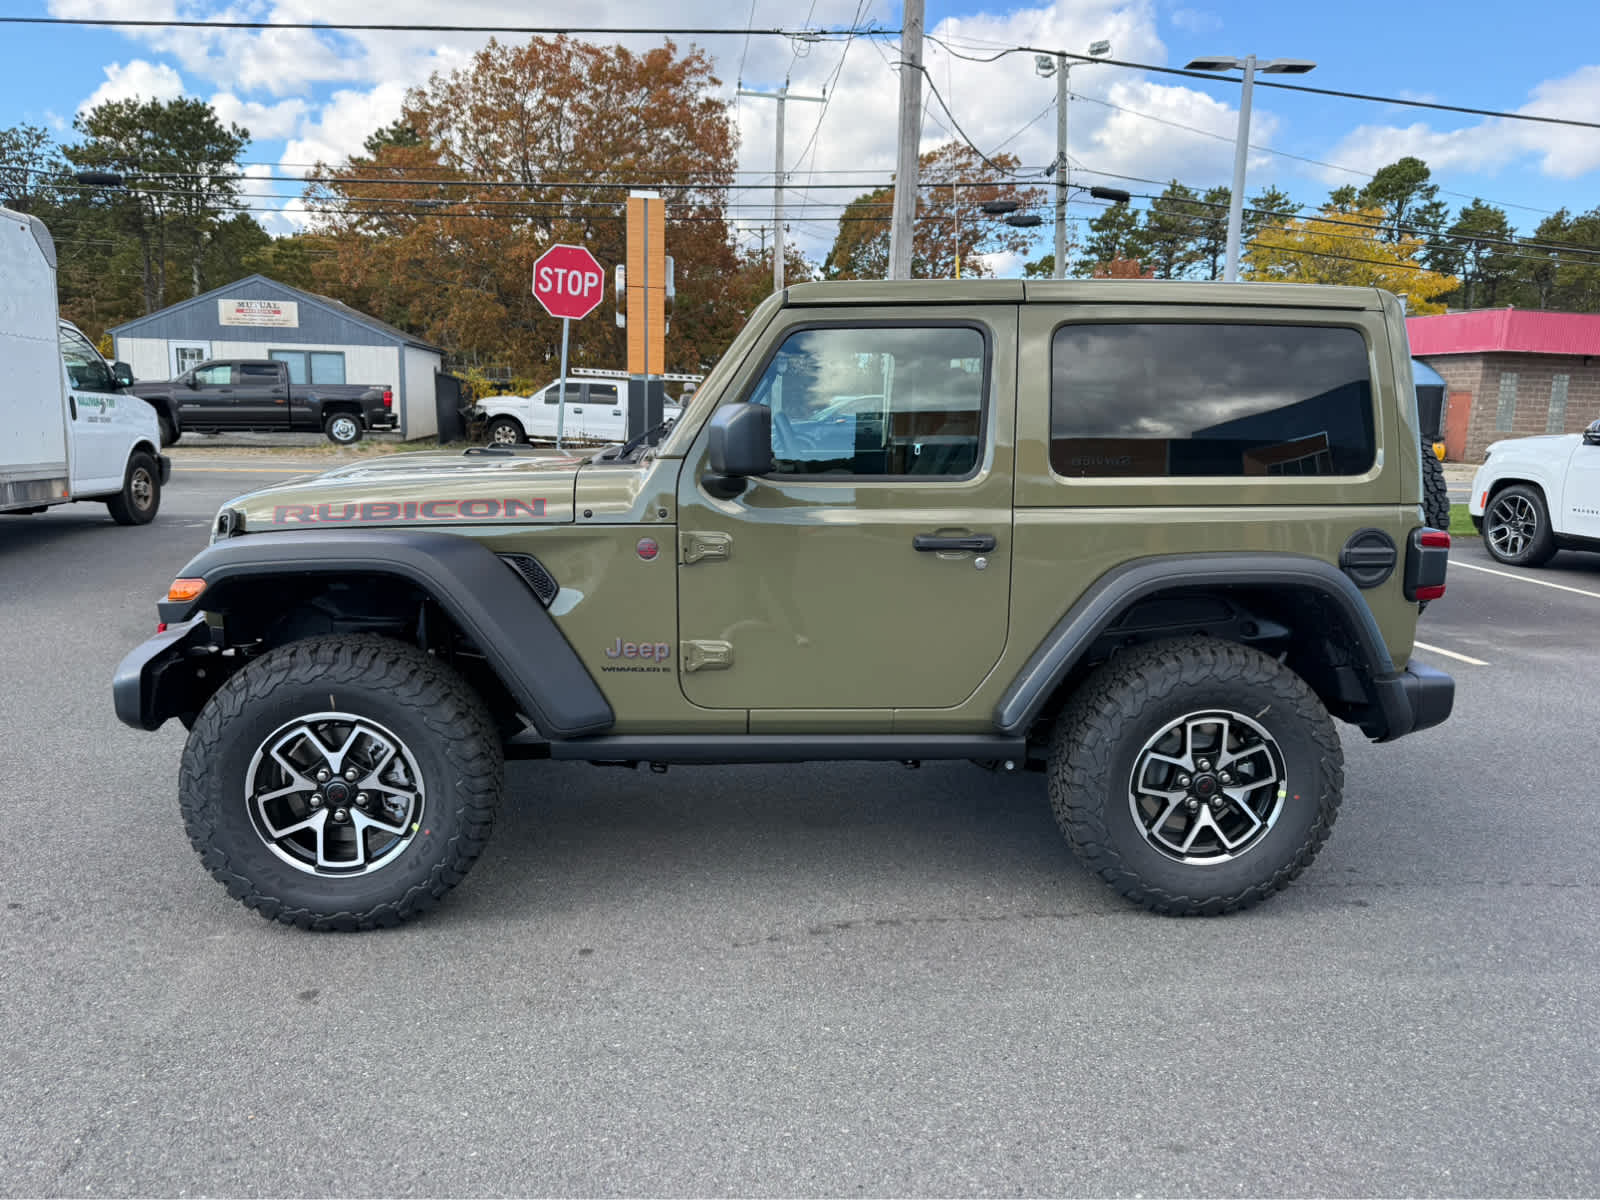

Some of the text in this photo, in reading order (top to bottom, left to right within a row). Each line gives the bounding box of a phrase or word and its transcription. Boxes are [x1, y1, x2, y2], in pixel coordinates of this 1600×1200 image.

[538, 266, 599, 297] STOP
[272, 498, 547, 524] RUBICON
[605, 637, 669, 663] Jeep
